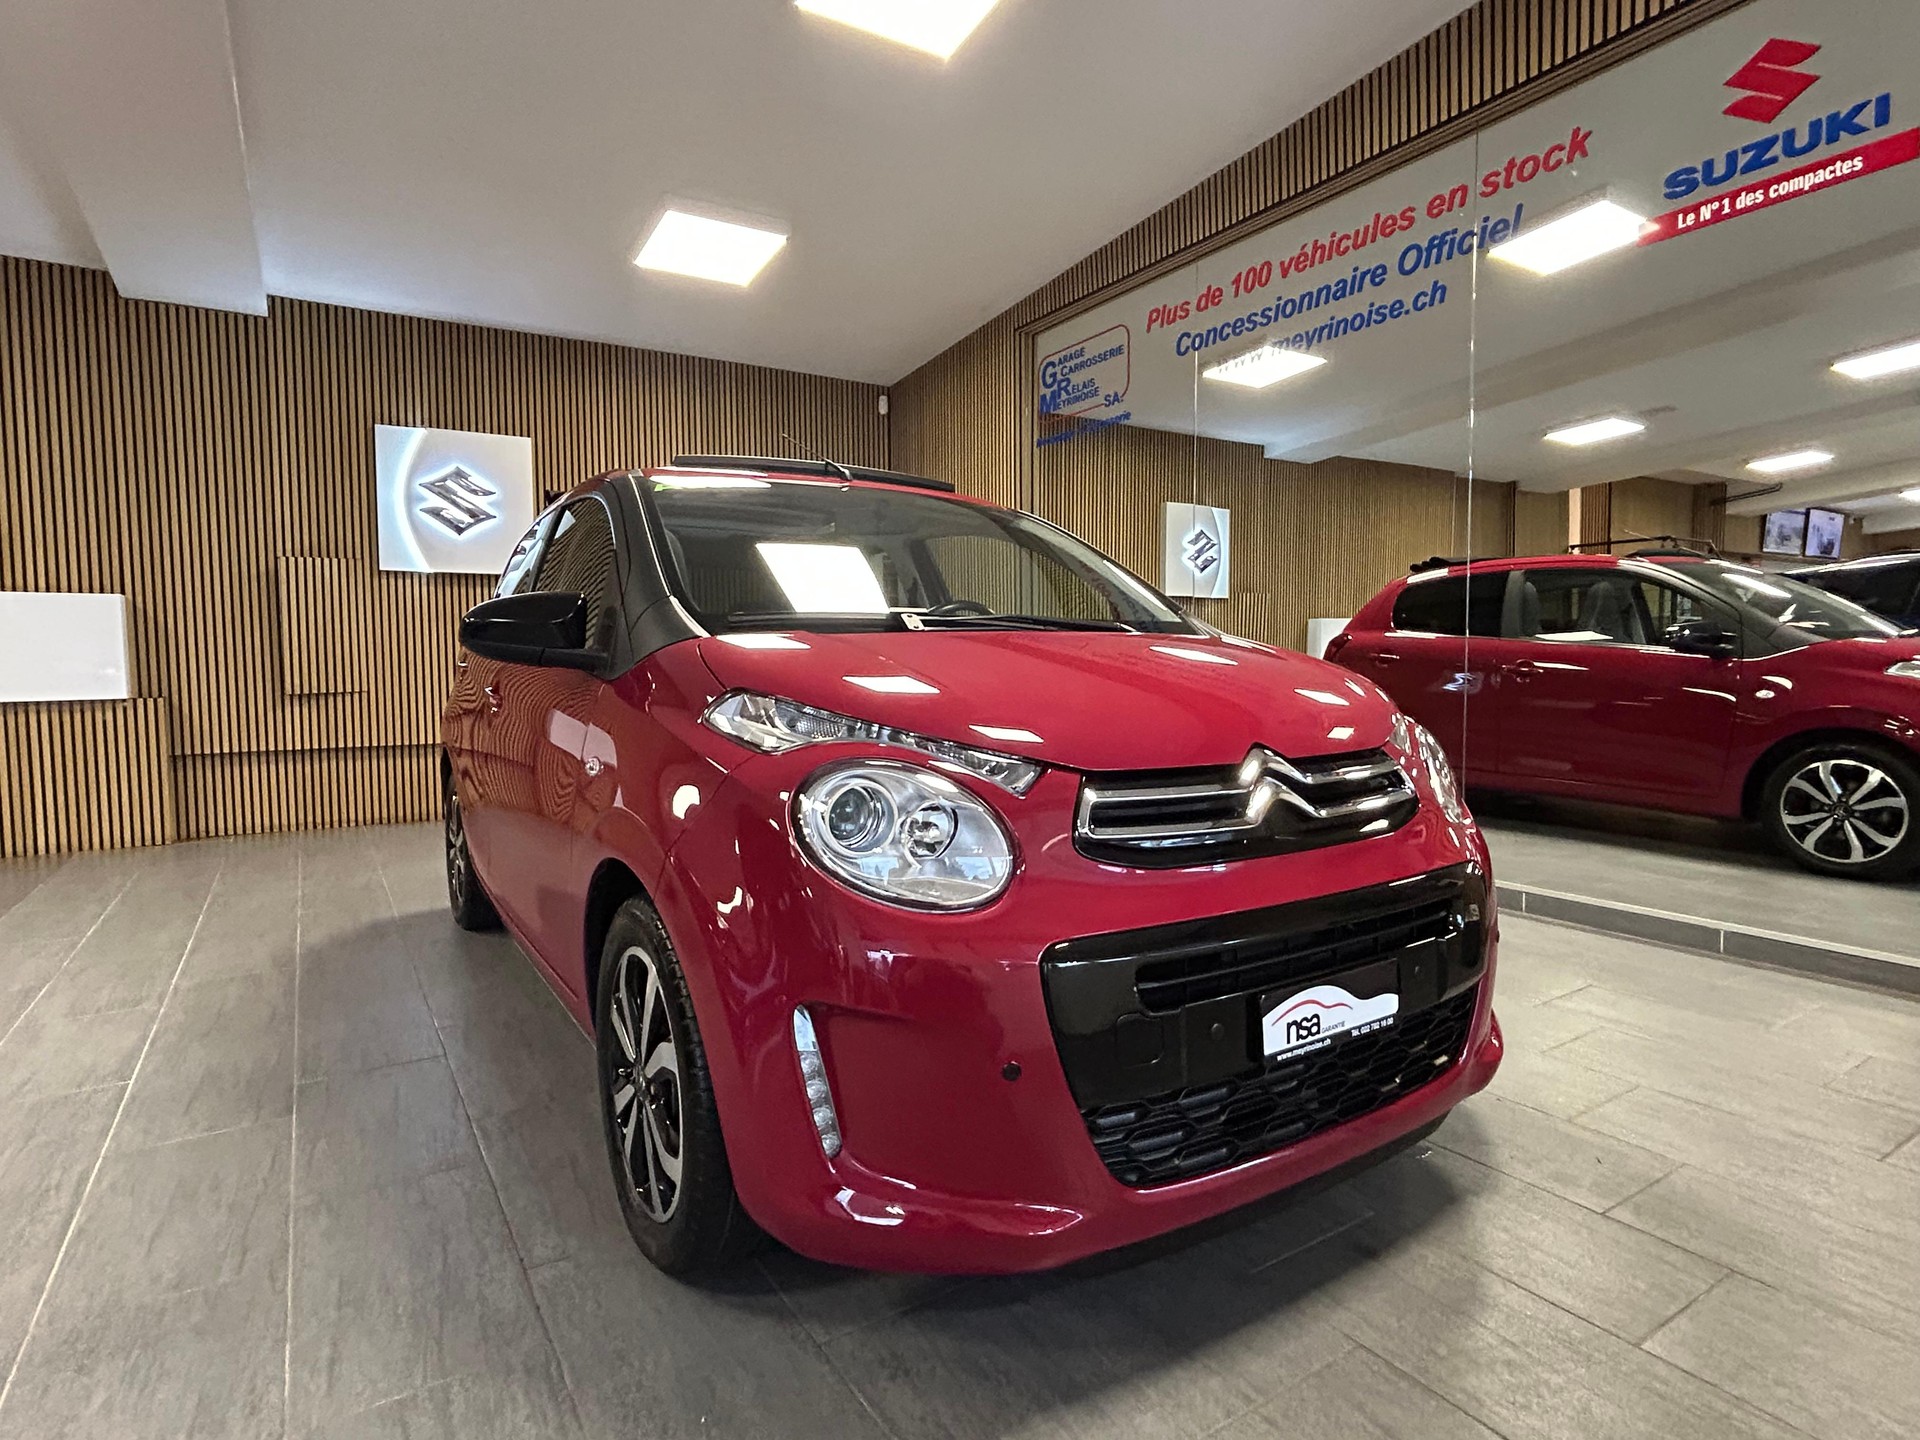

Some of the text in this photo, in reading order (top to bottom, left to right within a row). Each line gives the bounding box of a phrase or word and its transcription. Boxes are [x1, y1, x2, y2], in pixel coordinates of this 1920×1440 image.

[1663, 92, 1891, 200] SUZUKI
[1677, 211, 1696, 230] Le
[1735, 189, 1765, 211] des
[1769, 155, 1864, 198] compactes
[1146, 126, 1593, 333] Plus de 100 véhicules en stock
[1176, 203, 1524, 357] Concessionnaire Officiel
[1042, 347, 1086, 389] GARAGE
[1060, 344, 1125, 377] CARROSSERIE
[1057, 377, 1096, 400] RELAIS
[1286, 1013, 1321, 1045] nsa
[1321, 1020, 1346, 1034] GARANTIE
